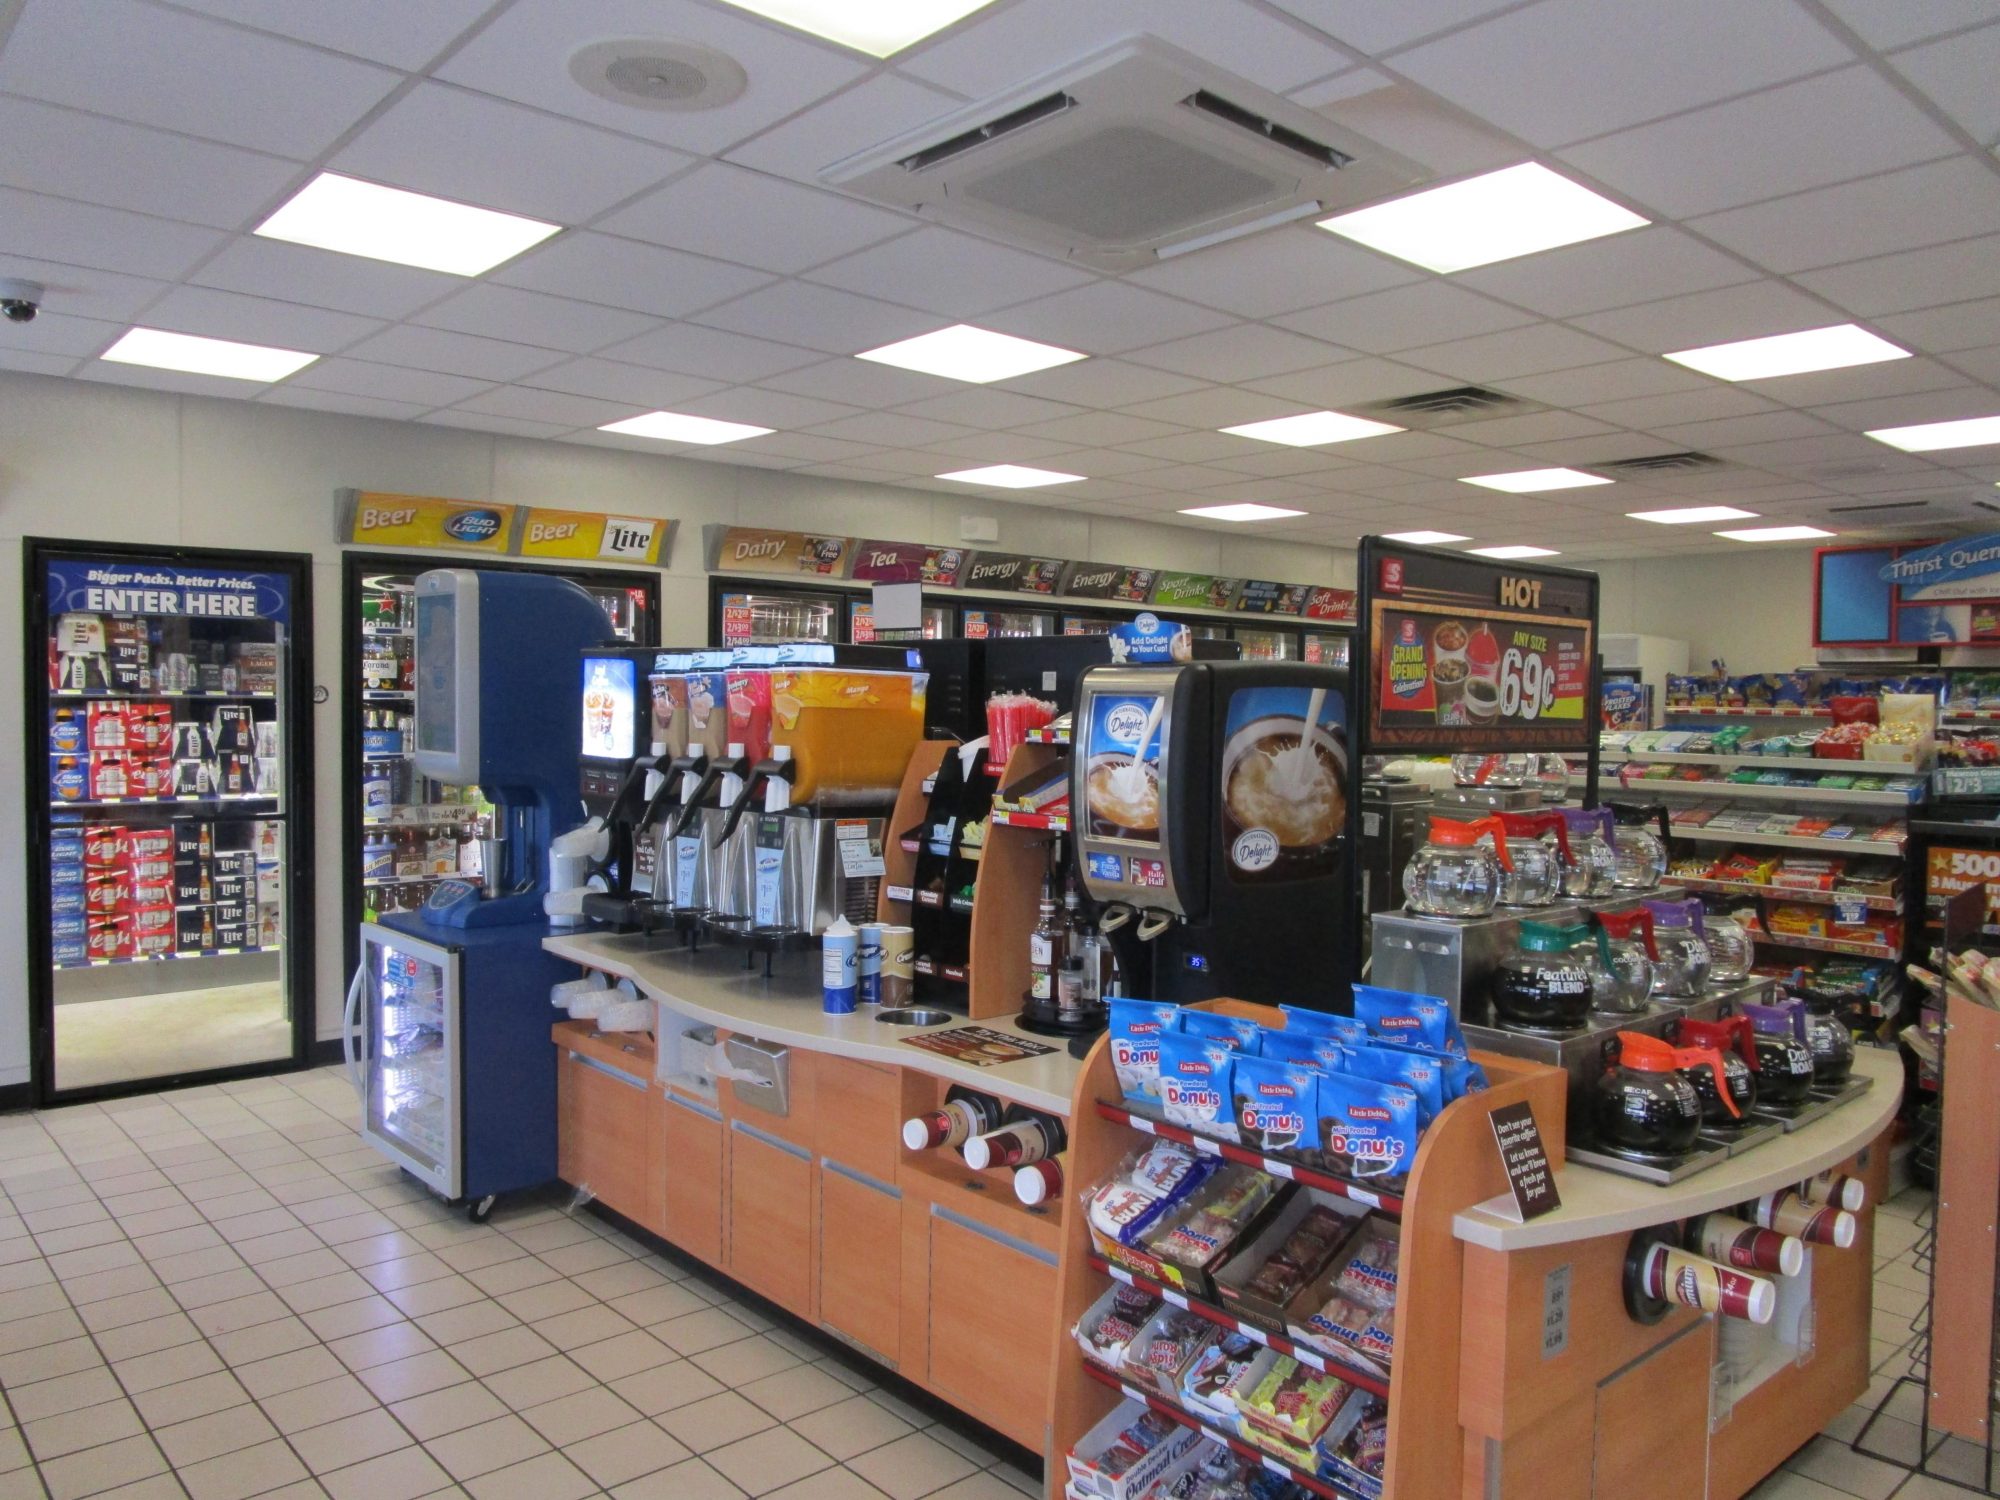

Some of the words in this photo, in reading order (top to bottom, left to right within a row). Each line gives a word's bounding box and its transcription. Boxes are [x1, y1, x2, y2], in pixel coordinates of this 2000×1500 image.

[362, 508, 417, 529] Beer
[461, 515, 495, 526] BUD
[453, 524, 498, 535] LIGHT
[530, 523, 578, 543] Beer
[609, 524, 650, 552] Lite
[735, 538, 786, 561] Dairy
[820, 549, 839, 559] Free
[870, 551, 897, 568] Tea
[940, 560, 957, 570] Free
[1891, 554, 1943, 579] Thirst
[971, 560, 1021, 580] Energy
[87, 570, 131, 586] Bigger
[133, 572, 174, 585] Packs.
[176, 575, 214, 588] Better
[214, 577, 256, 590] Prices.
[1072, 570, 1117, 589] Energy
[1135, 579, 1147, 588] Free
[1160, 576, 1189, 592] Sport
[1173, 583, 1206, 600] Drinks
[1311, 591, 1331, 606] Soft
[1501, 575, 1542, 609] HOT
[87, 588, 177, 614] ENTER
[186, 592, 256, 617] HERE
[1319, 600, 1349, 615] Drinks
[1131, 636, 1145, 645] Add
[1145, 636, 1168, 646] Delight
[1513, 631, 1529, 648] ANY
[1530, 634, 1548, 652] SIZE
[119, 646, 138, 657] Lite
[1132, 645, 1139, 653] to
[1139, 645, 1153, 653] Your
[1153, 644, 1168, 655] Cup!
[1393, 644, 1423, 663] GRAND
[121, 671, 139, 683] Lite
[1389, 660, 1428, 681] OPENING
[845, 684, 870, 695] Mango
[1605, 702, 1632, 712] FLAKES
[222, 710, 239, 721] Lite
[1110, 716, 1144, 738] Delight
[181, 783, 197, 793] Lite
[180, 841, 198, 851] Lite
[1238, 842, 1272, 865] Delight
[220, 860, 241, 871] Lite
[1100, 862, 1120, 872] French
[1951, 853, 2000, 876] 500
[1101, 869, 1120, 879] Vanilla
[1148, 870, 1161, 879] Half
[1148, 876, 1164, 886] Half
[180, 886, 198, 898] Lite
[221, 883, 241, 895] Lite
[222, 907, 242, 919] Lite
[183, 931, 200, 943] Lite
[223, 931, 243, 944] Lite
[1536, 967, 1588, 983] Featured
[1548, 981, 1585, 994] BLEND
[1130, 1024, 1143, 1033] Little
[1381, 1018, 1397, 1027] Little
[1398, 1019, 1420, 1027] Debbie
[1131, 1039, 1159, 1047] Powdered
[1118, 1048, 1159, 1066] Donu
[1180, 1062, 1193, 1071] Little
[1194, 1064, 1211, 1073] Debbie
[1167, 1087, 1221, 1107] Donuts
[1260, 1084, 1274, 1094] Little
[1274, 1086, 1294, 1096] Debbie
[1242, 1110, 1304, 1131] Donuts
[1349, 1107, 1366, 1117] Little
[1367, 1109, 1390, 1119] Debbie
[1331, 1126, 1348, 1135] Mini
[1349, 1127, 1376, 1135] Frosted
[1497, 1121, 1512, 1135] Don't
[1512, 1120, 1521, 1130] see
[1520, 1117, 1532, 1130] your
[1331, 1135, 1405, 1157] Donuts
[1500, 1131, 1520, 1151] favorite
[1520, 1127, 1537, 1142] coffee?
[1509, 1153, 1518, 1163] Let
[1518, 1151, 1525, 1160] us
[1524, 1147, 1539, 1157] know
[1510, 1166, 1521, 1177] and
[1521, 1159, 1534, 1173] we'll
[1533, 1158, 1547, 1169] brew
[1523, 1173, 1536, 1189] fresh
[1536, 1171, 1546, 1184] pot
[1526, 1188, 1535, 1202] for
[1112, 1193, 1152, 1226] BUN
[1177, 1224, 1219, 1248] DONUT
[1350, 1259, 1398, 1284] DONUT
[1343, 1269, 1395, 1292] STICKS
[1308, 1313, 1360, 1342] DONUT
